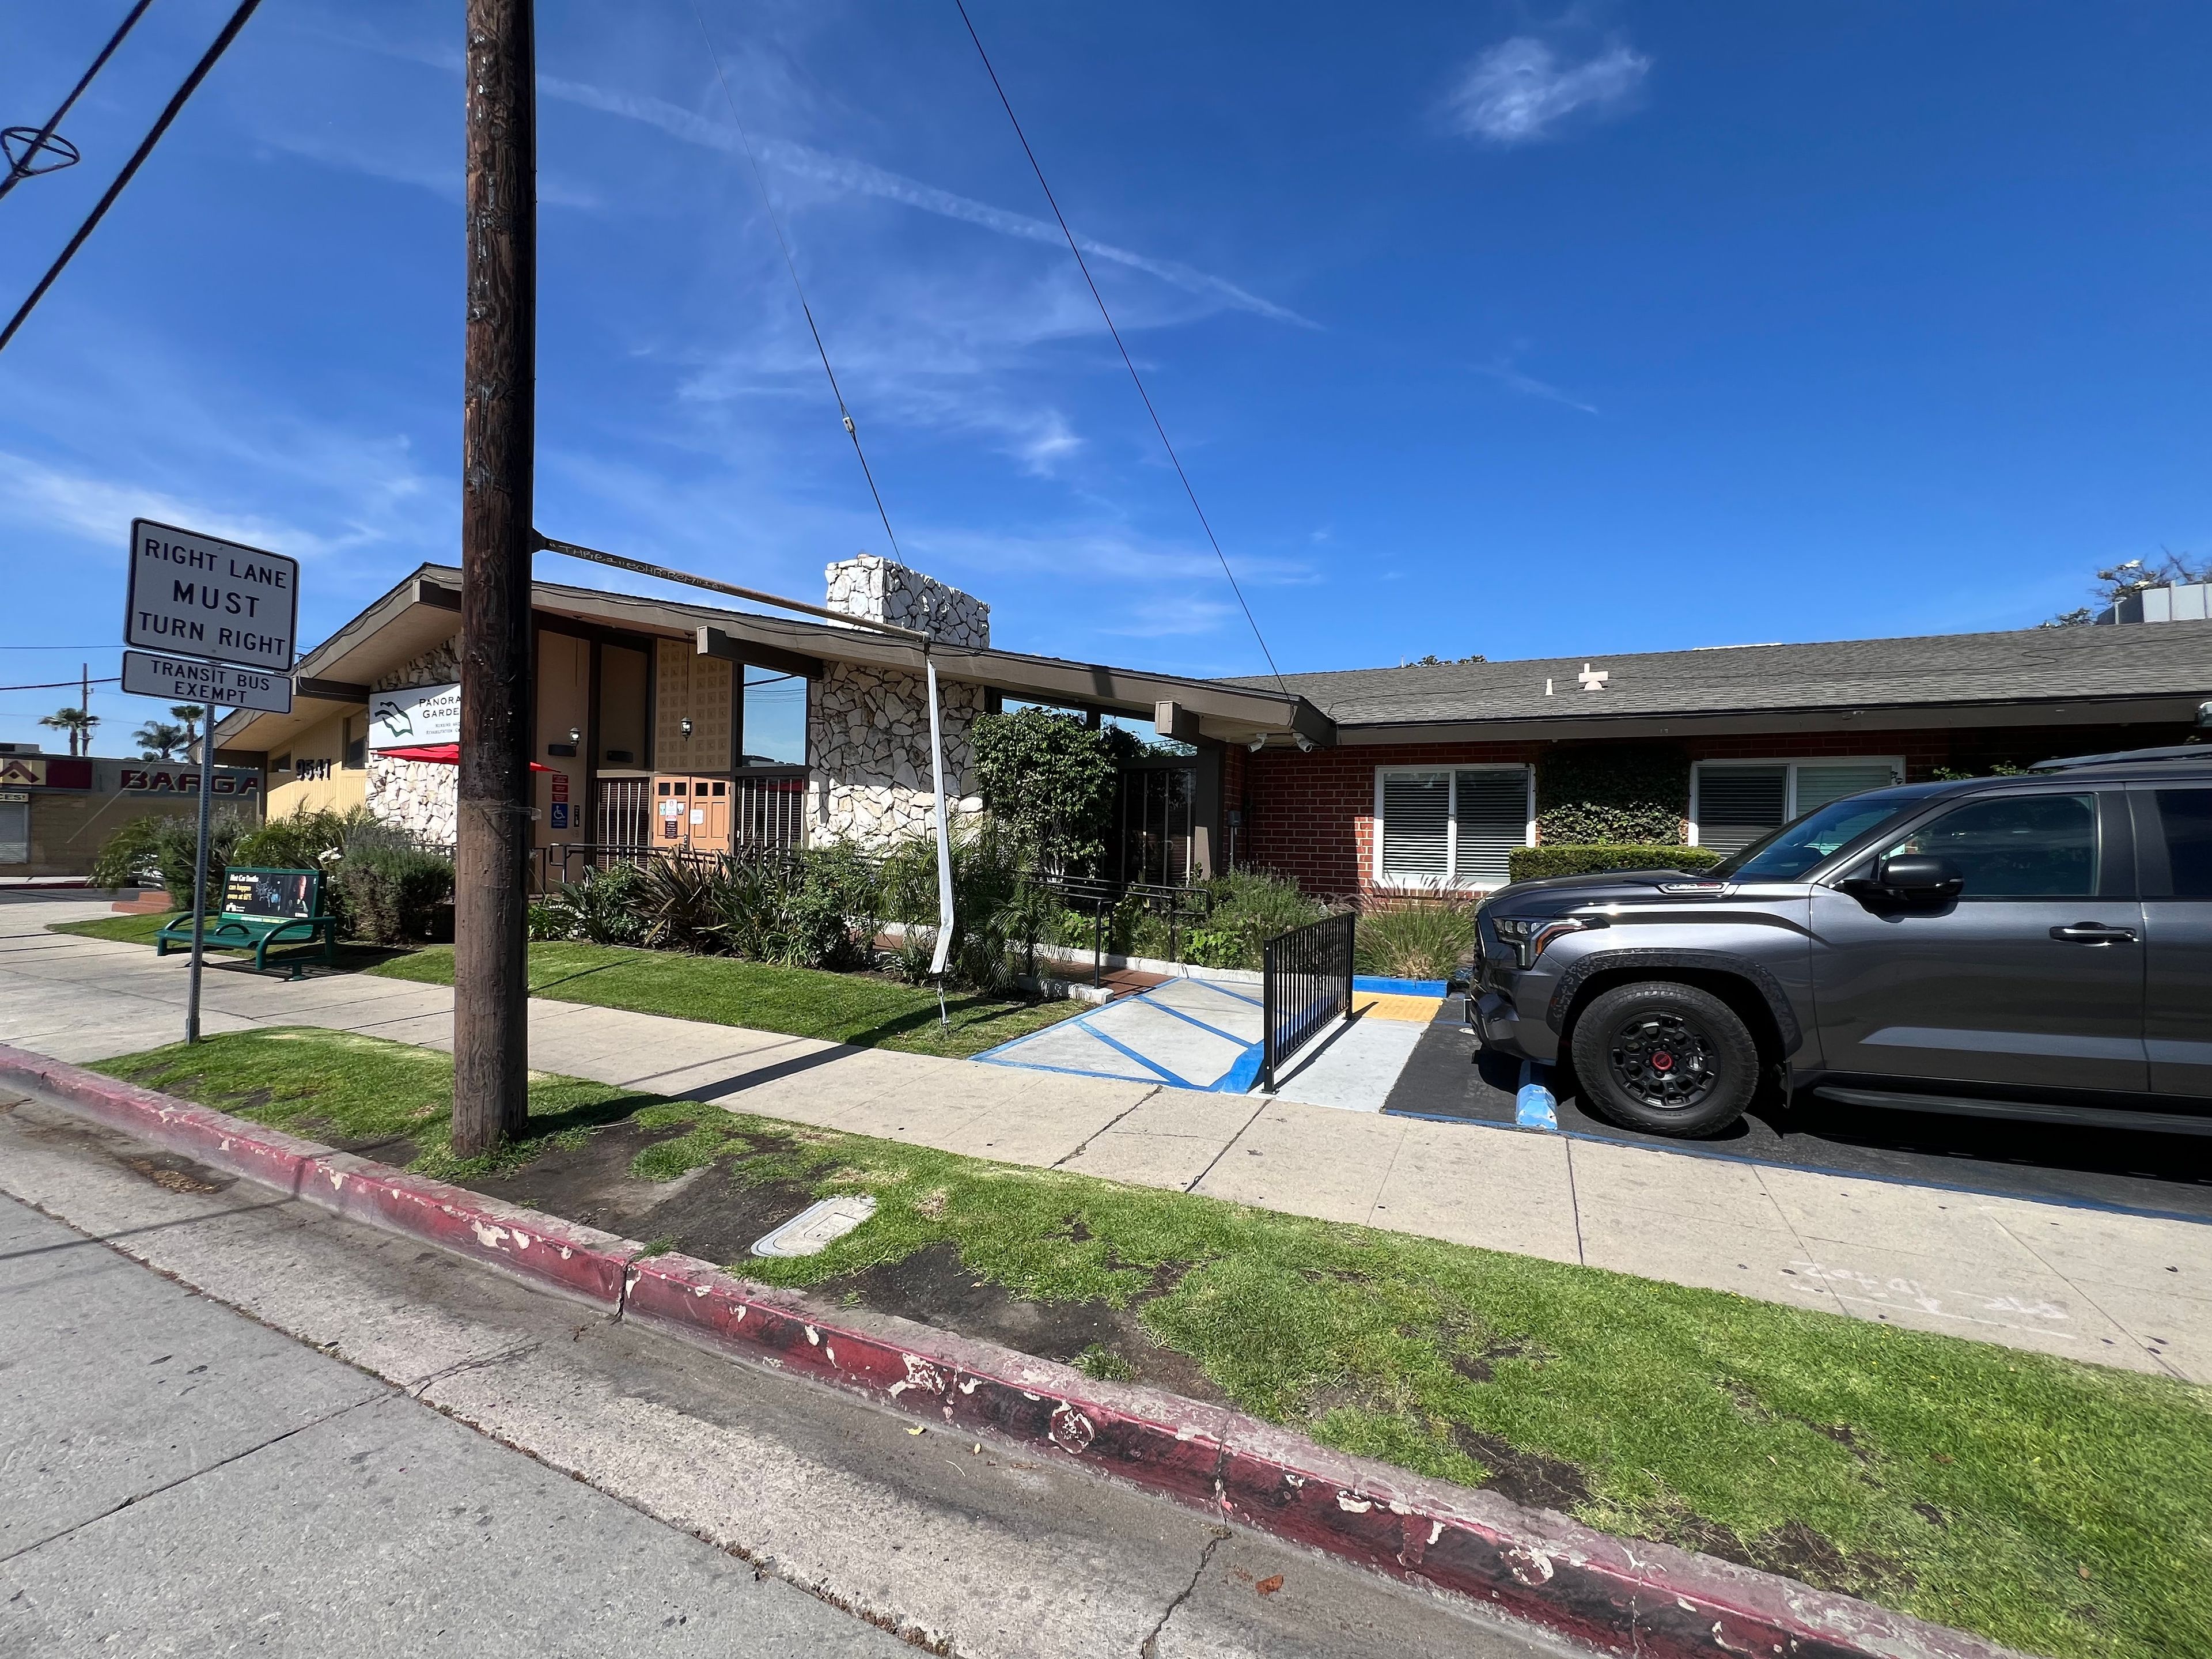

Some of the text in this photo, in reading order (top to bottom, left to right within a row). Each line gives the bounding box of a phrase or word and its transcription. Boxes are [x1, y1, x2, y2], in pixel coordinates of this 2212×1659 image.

[145, 538, 287, 589] RIGHT LANE
[173, 579, 260, 618] MUST
[138, 611, 286, 656] TURN RIGHT
[151, 660, 270, 691] TRANSIT BUS
[175, 681, 247, 703] EXEMPT
[423, 708, 459, 718] GARDE
[296, 759, 331, 781] 9541
